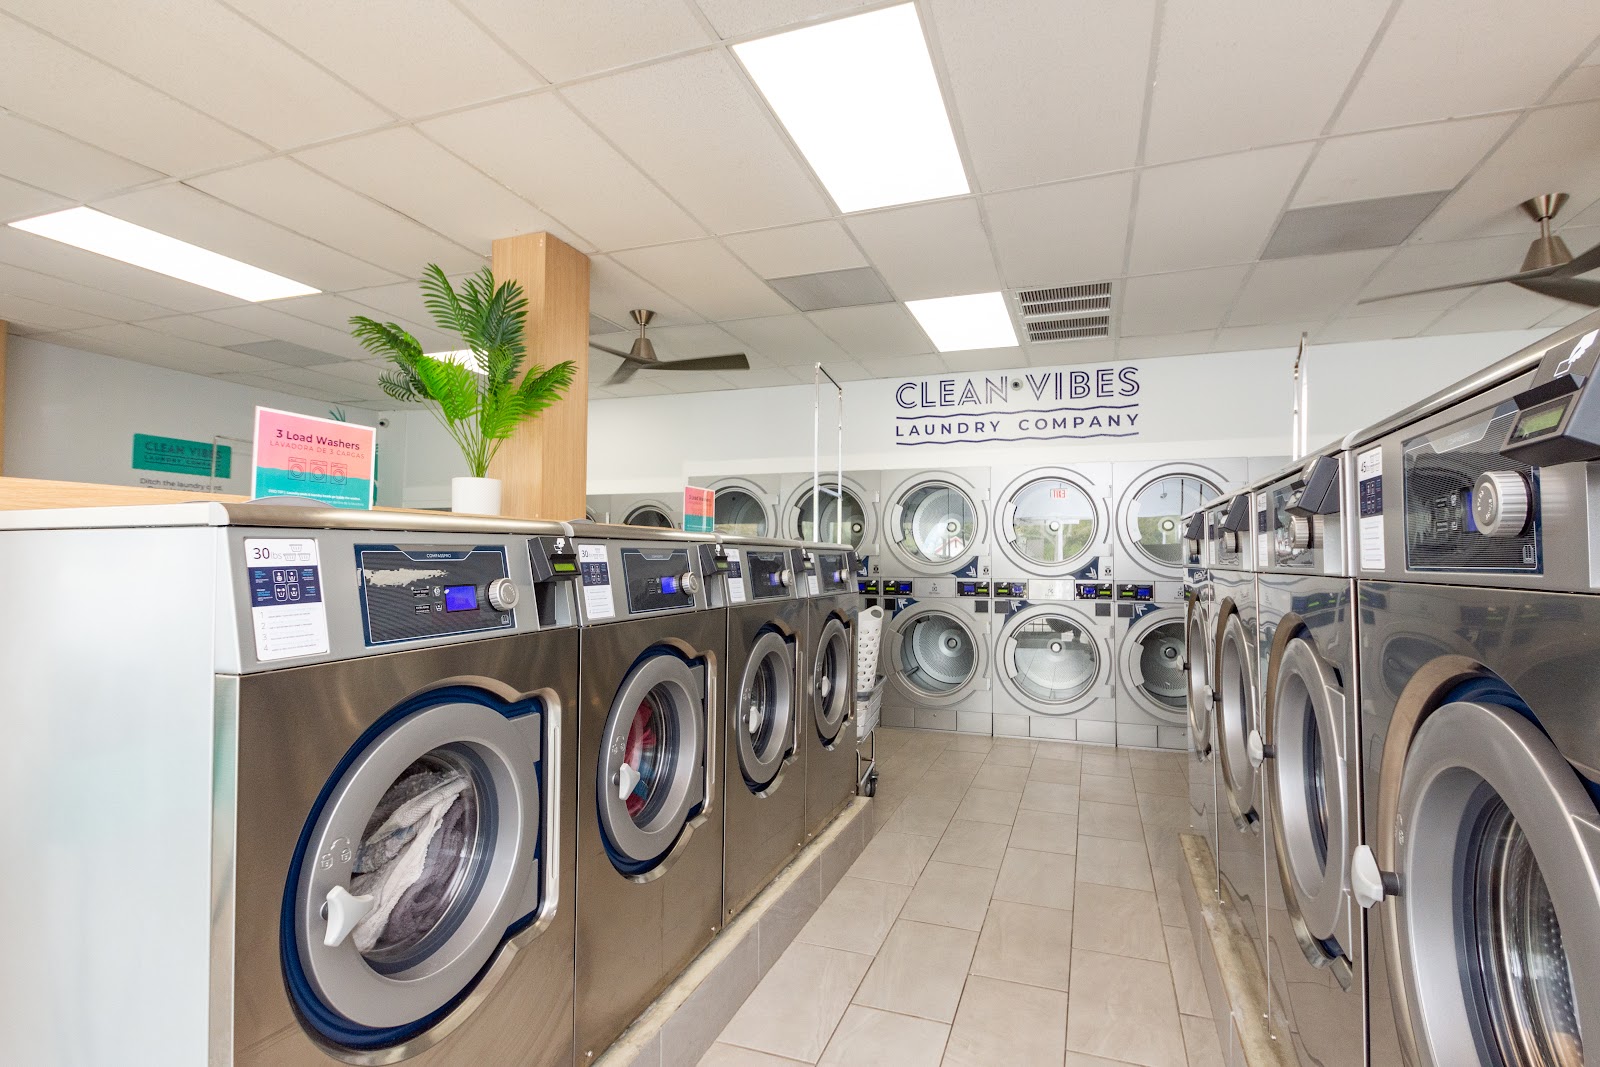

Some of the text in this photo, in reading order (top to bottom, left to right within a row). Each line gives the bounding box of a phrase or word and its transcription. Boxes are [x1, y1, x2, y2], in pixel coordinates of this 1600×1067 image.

[895, 366, 1140, 409] CLEAN VIBES
[895, 413, 1139, 437] LAUNDRY COMPANY
[145, 441, 185, 454] CLEAN
[269, 440, 314, 452] LAVADORA
[336, 449, 365, 460] CARGAS
[276, 429, 360, 451] 3 Load Washers
[186, 459, 221, 468] COMPAY
[140, 478, 161, 486] Ditch
[163, 479, 176, 487] the
[177, 481, 204, 490] laundry
